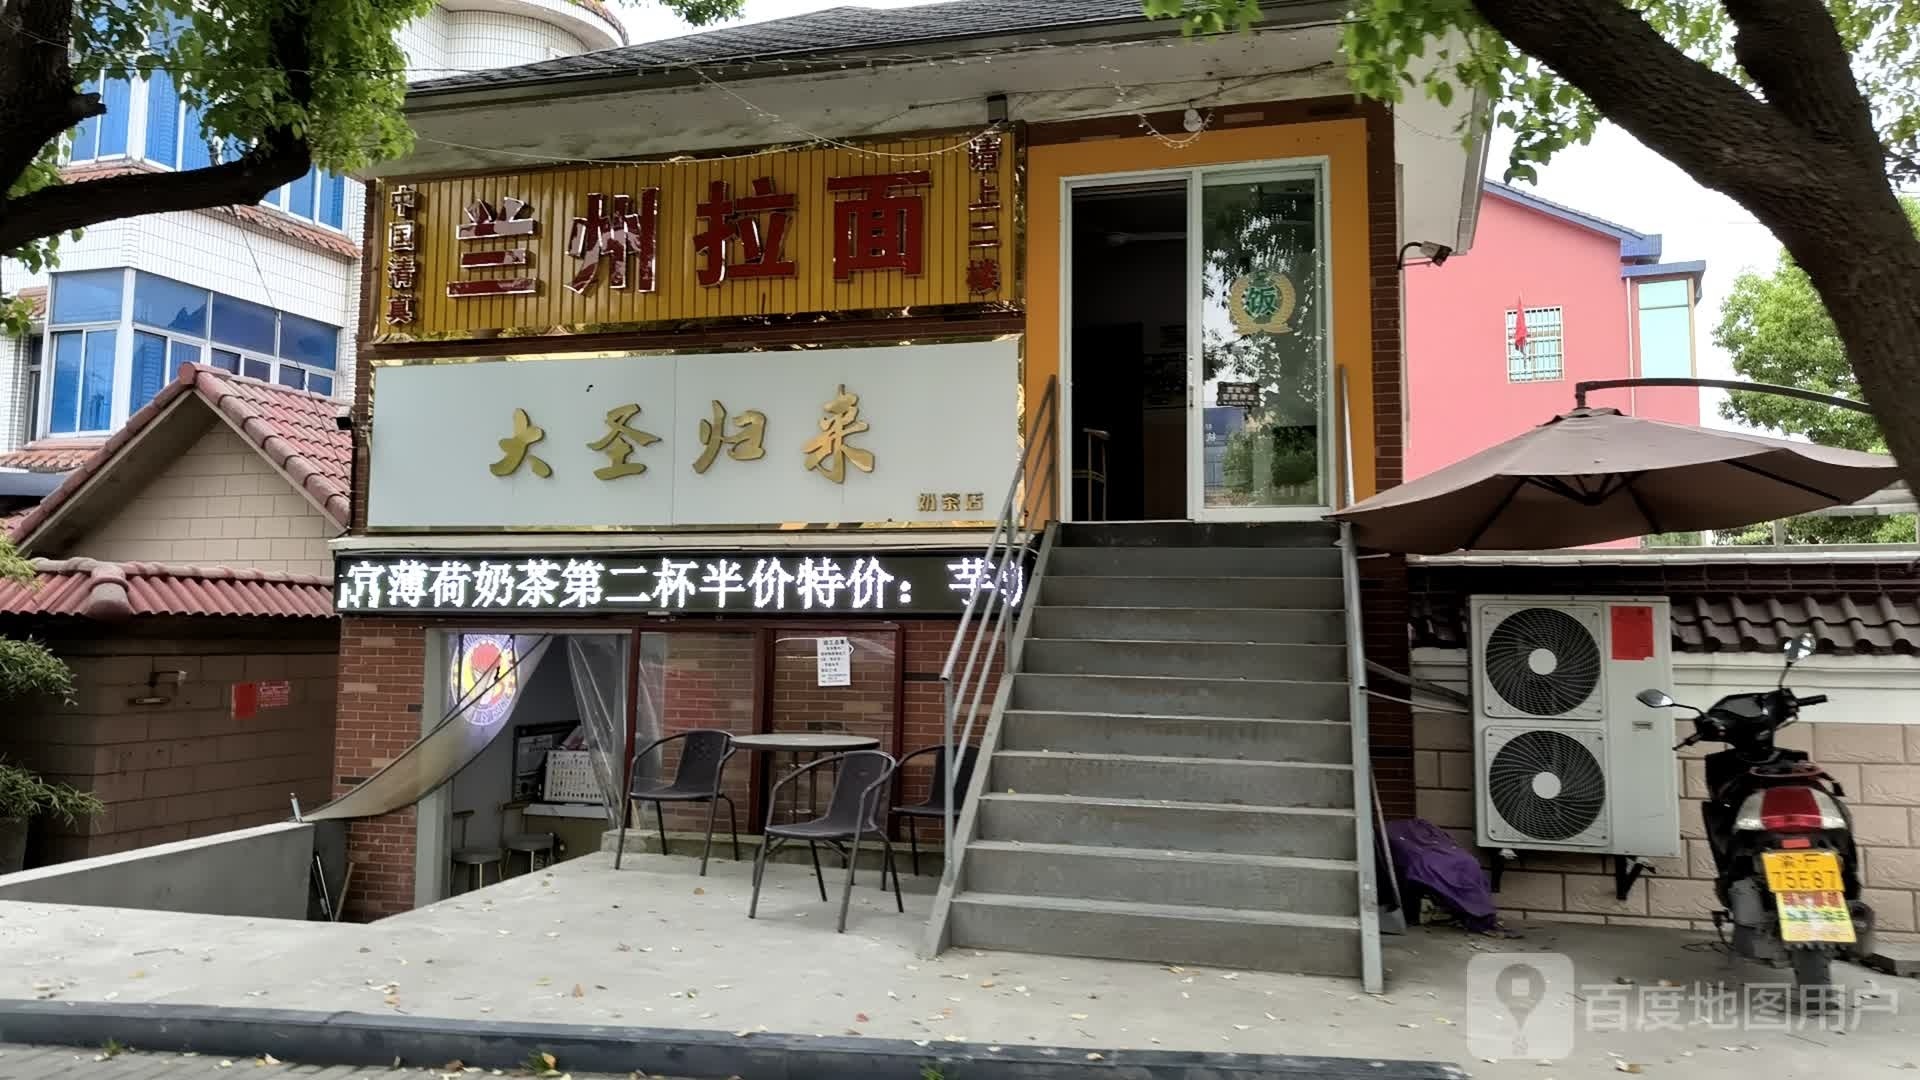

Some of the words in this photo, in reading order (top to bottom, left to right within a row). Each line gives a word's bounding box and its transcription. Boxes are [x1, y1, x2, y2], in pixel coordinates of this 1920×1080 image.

[385, 184, 417, 326] 中国清真
[447, 171, 931, 298] 兰州拉面
[489, 383, 876, 484] 大圣归来
[916, 492, 985, 512] 奶茶店
